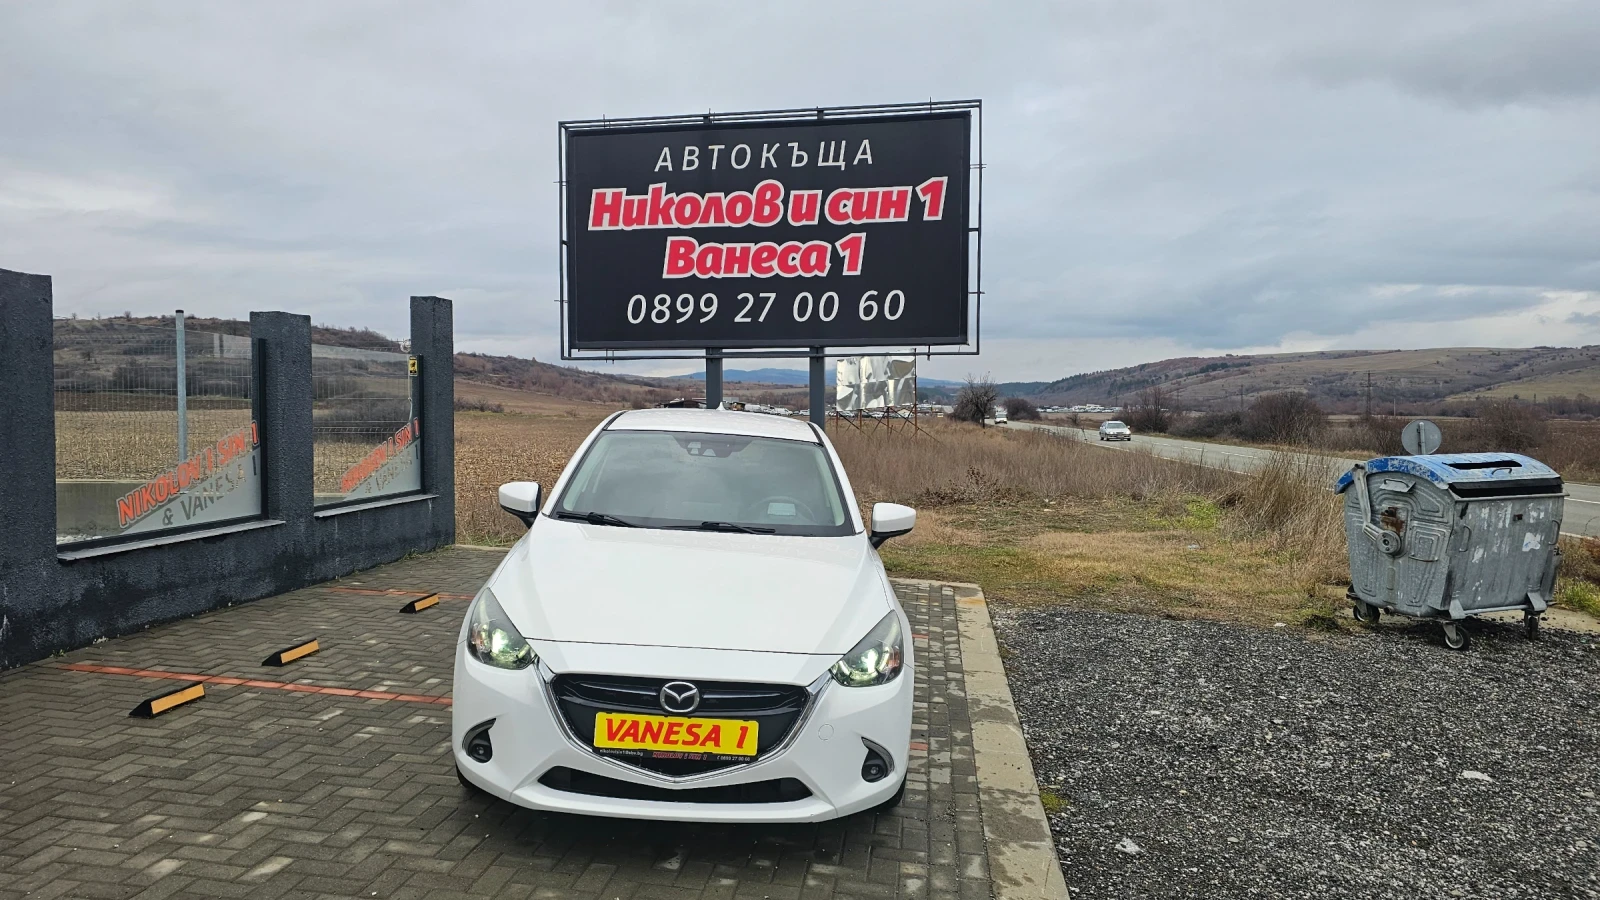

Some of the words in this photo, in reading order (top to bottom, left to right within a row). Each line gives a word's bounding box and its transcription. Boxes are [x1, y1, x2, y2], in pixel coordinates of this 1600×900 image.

[654, 139, 874, 171] АВТОКЪЩА
[588, 179, 784, 230] Николов
[787, 190, 822, 226] и
[825, 186, 913, 226] син
[915, 176, 948, 222] 1
[663, 236, 832, 279] Ванеса
[835, 232, 866, 276] 1
[628, 293, 718, 325] 0899
[734, 292, 777, 323] 27
[793, 291, 840, 323] 00
[859, 290, 906, 321] 60
[116, 454, 201, 528] NIKOLOV
[217, 429, 246, 465] SIN
[251, 420, 259, 446] 1
[162, 508, 173, 526] &
[180, 464, 246, 521] VANESA
[606, 718, 722, 748] VANESA
[736, 725, 749, 749] 1
